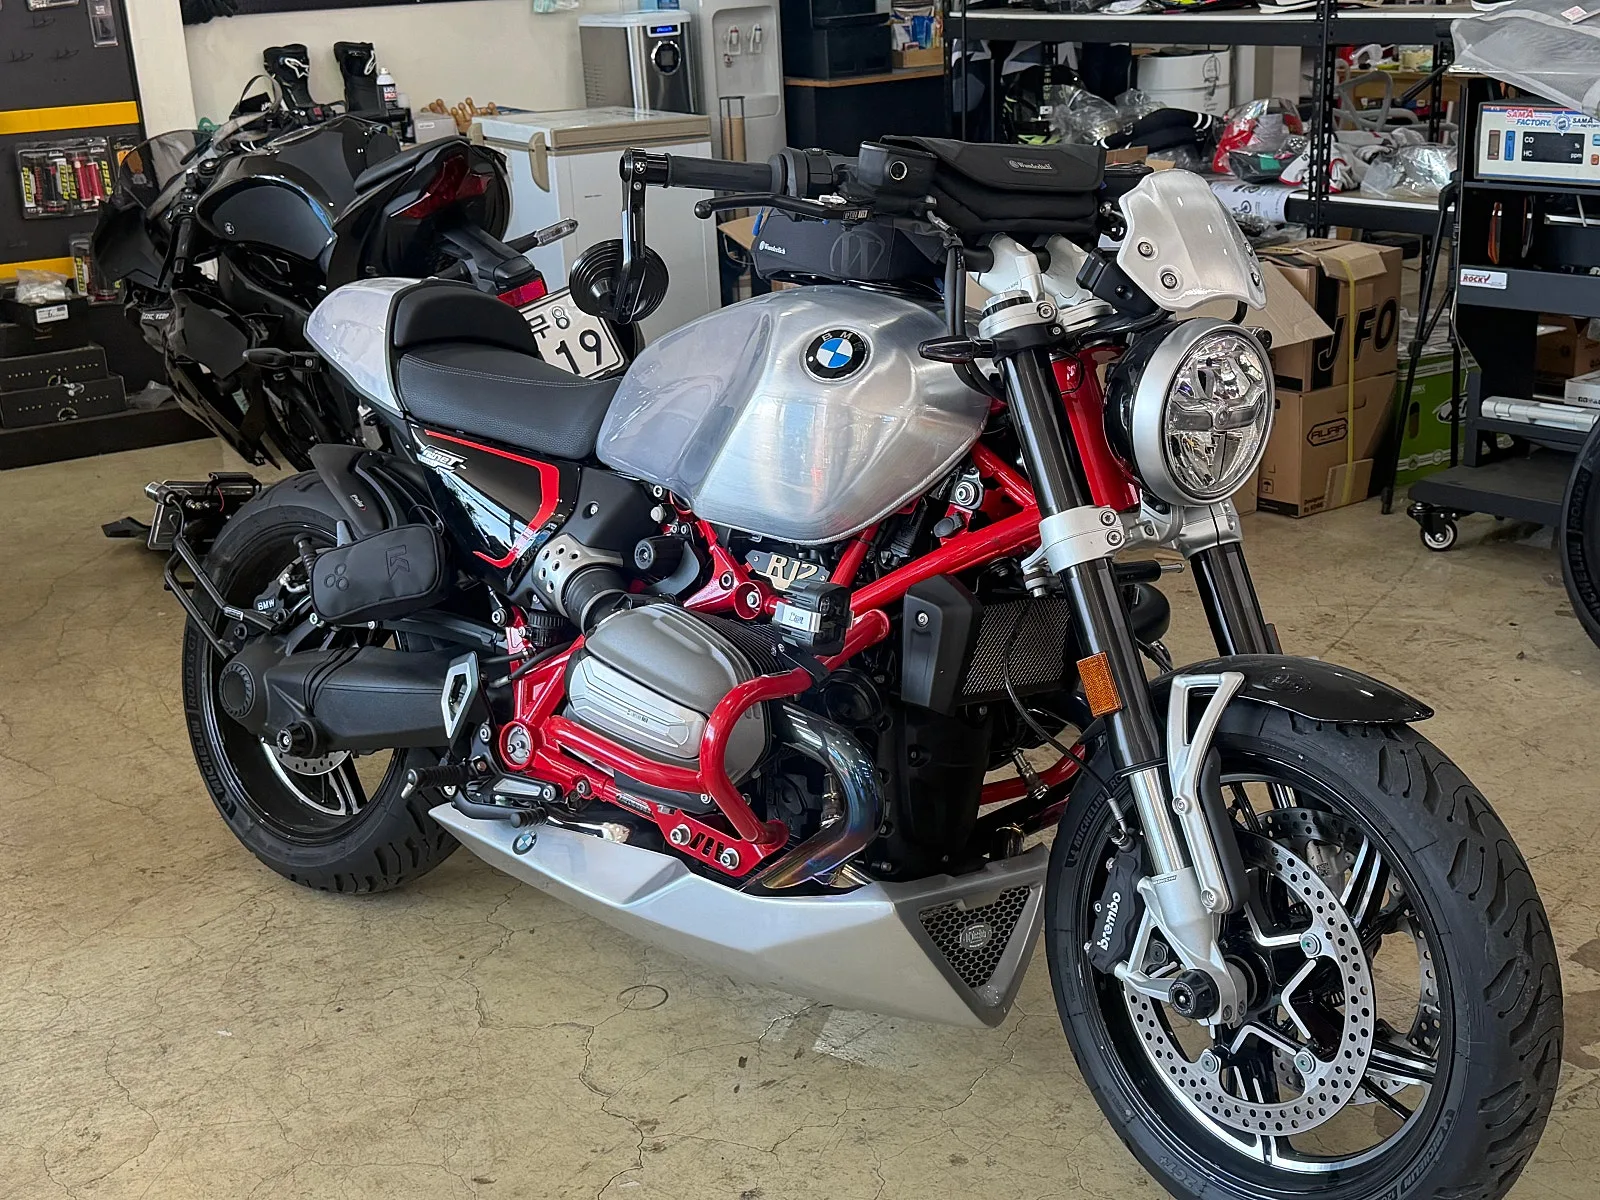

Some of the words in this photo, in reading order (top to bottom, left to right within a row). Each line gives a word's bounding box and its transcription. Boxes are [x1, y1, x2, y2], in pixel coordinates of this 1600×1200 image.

[1516, 119, 1551, 127] FACTORY
[1524, 136, 1534, 144] CO
[1463, 274, 1491, 284] ROCKY
[257, 598, 275, 611] BMW
[186, 666, 197, 708] ROAD
[1073, 792, 1106, 849] MICHELIN
[1097, 891, 1121, 952] brembo
[1403, 1128, 1446, 1189] MICHELIN
